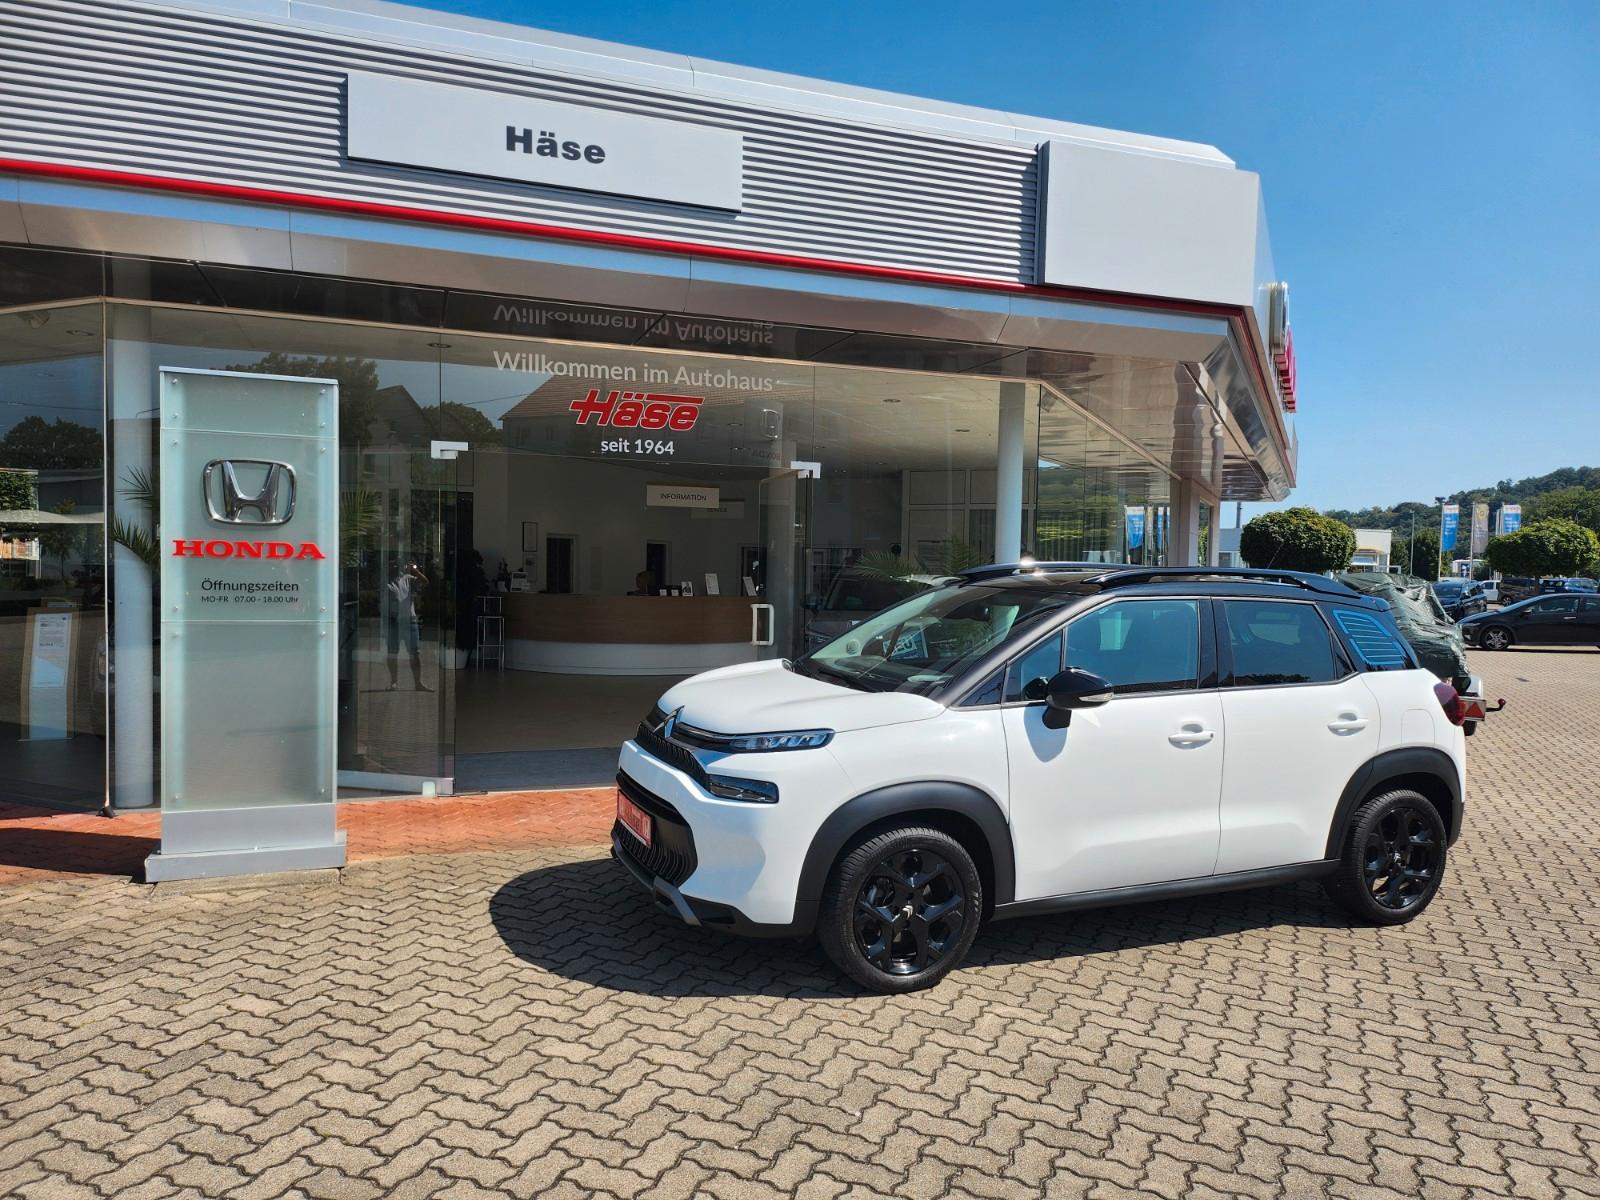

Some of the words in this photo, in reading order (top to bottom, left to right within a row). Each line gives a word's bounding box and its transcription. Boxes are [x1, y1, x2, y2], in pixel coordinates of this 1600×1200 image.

[505, 125, 606, 165] Häse
[493, 350, 637, 381] Willkommen
[643, 362, 669, 384] im
[673, 366, 773, 391] Autohaus
[569, 388, 705, 431] Häse
[600, 437, 630, 454] seit
[634, 438, 675, 456] 1964
[660, 492, 707, 501] INFORMATION
[172, 539, 326, 561] HONDA
[201, 577, 299, 594] Öffnungszeiten
